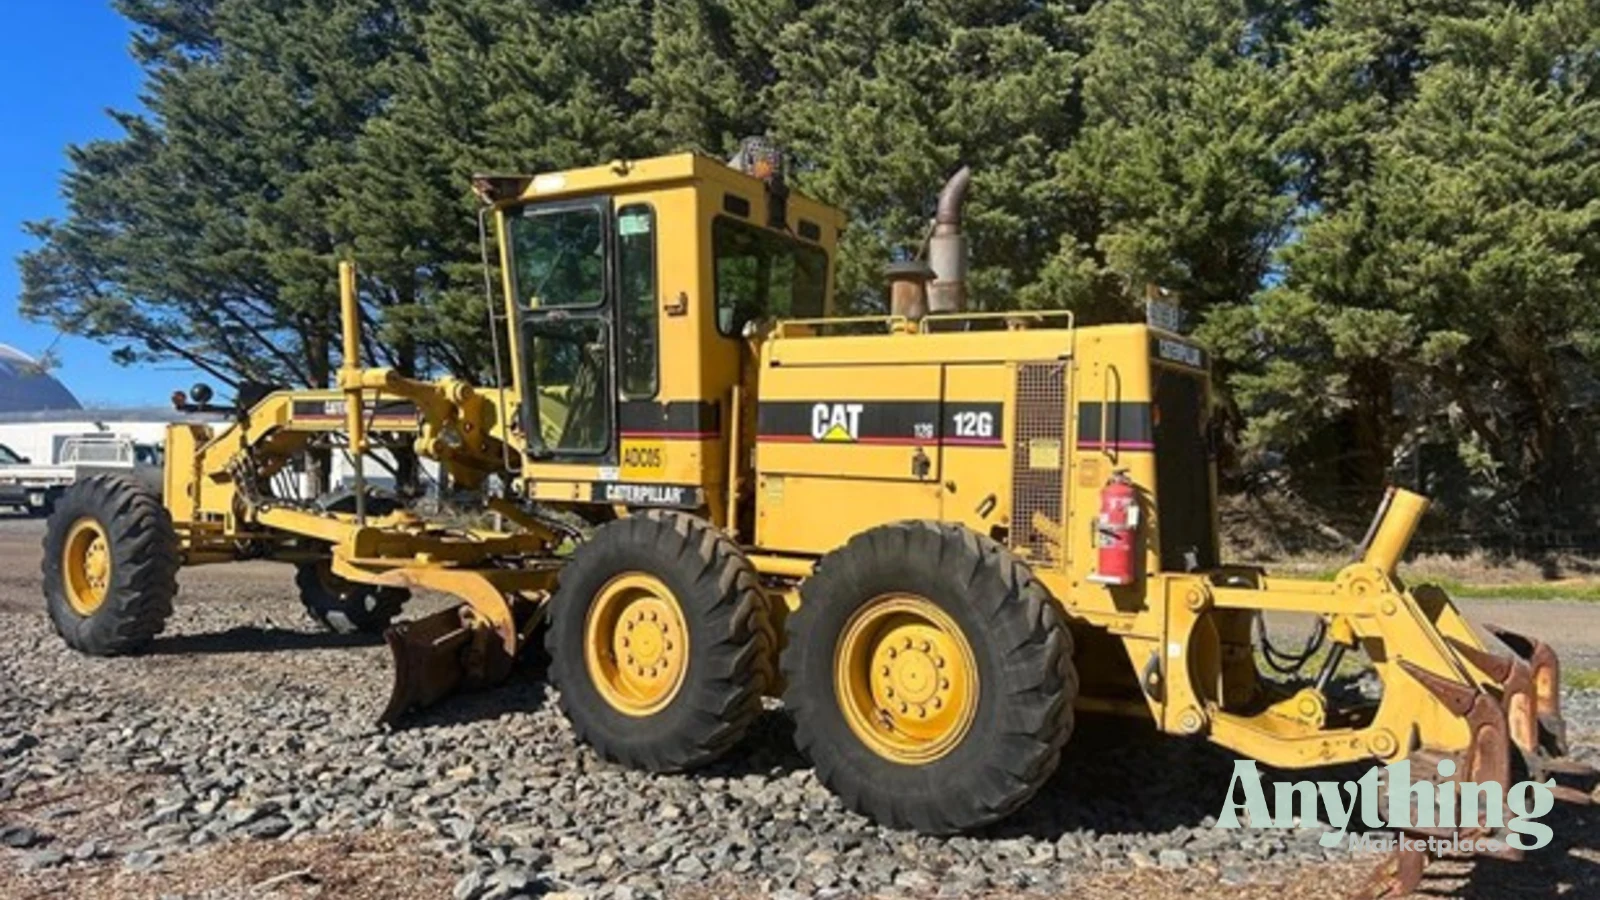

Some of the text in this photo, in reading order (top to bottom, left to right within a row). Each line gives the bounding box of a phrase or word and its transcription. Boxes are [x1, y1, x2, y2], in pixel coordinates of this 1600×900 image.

[811, 403, 863, 440] CAT
[953, 412, 993, 436] 12G
[606, 484, 682, 506] CATERPILLAR
